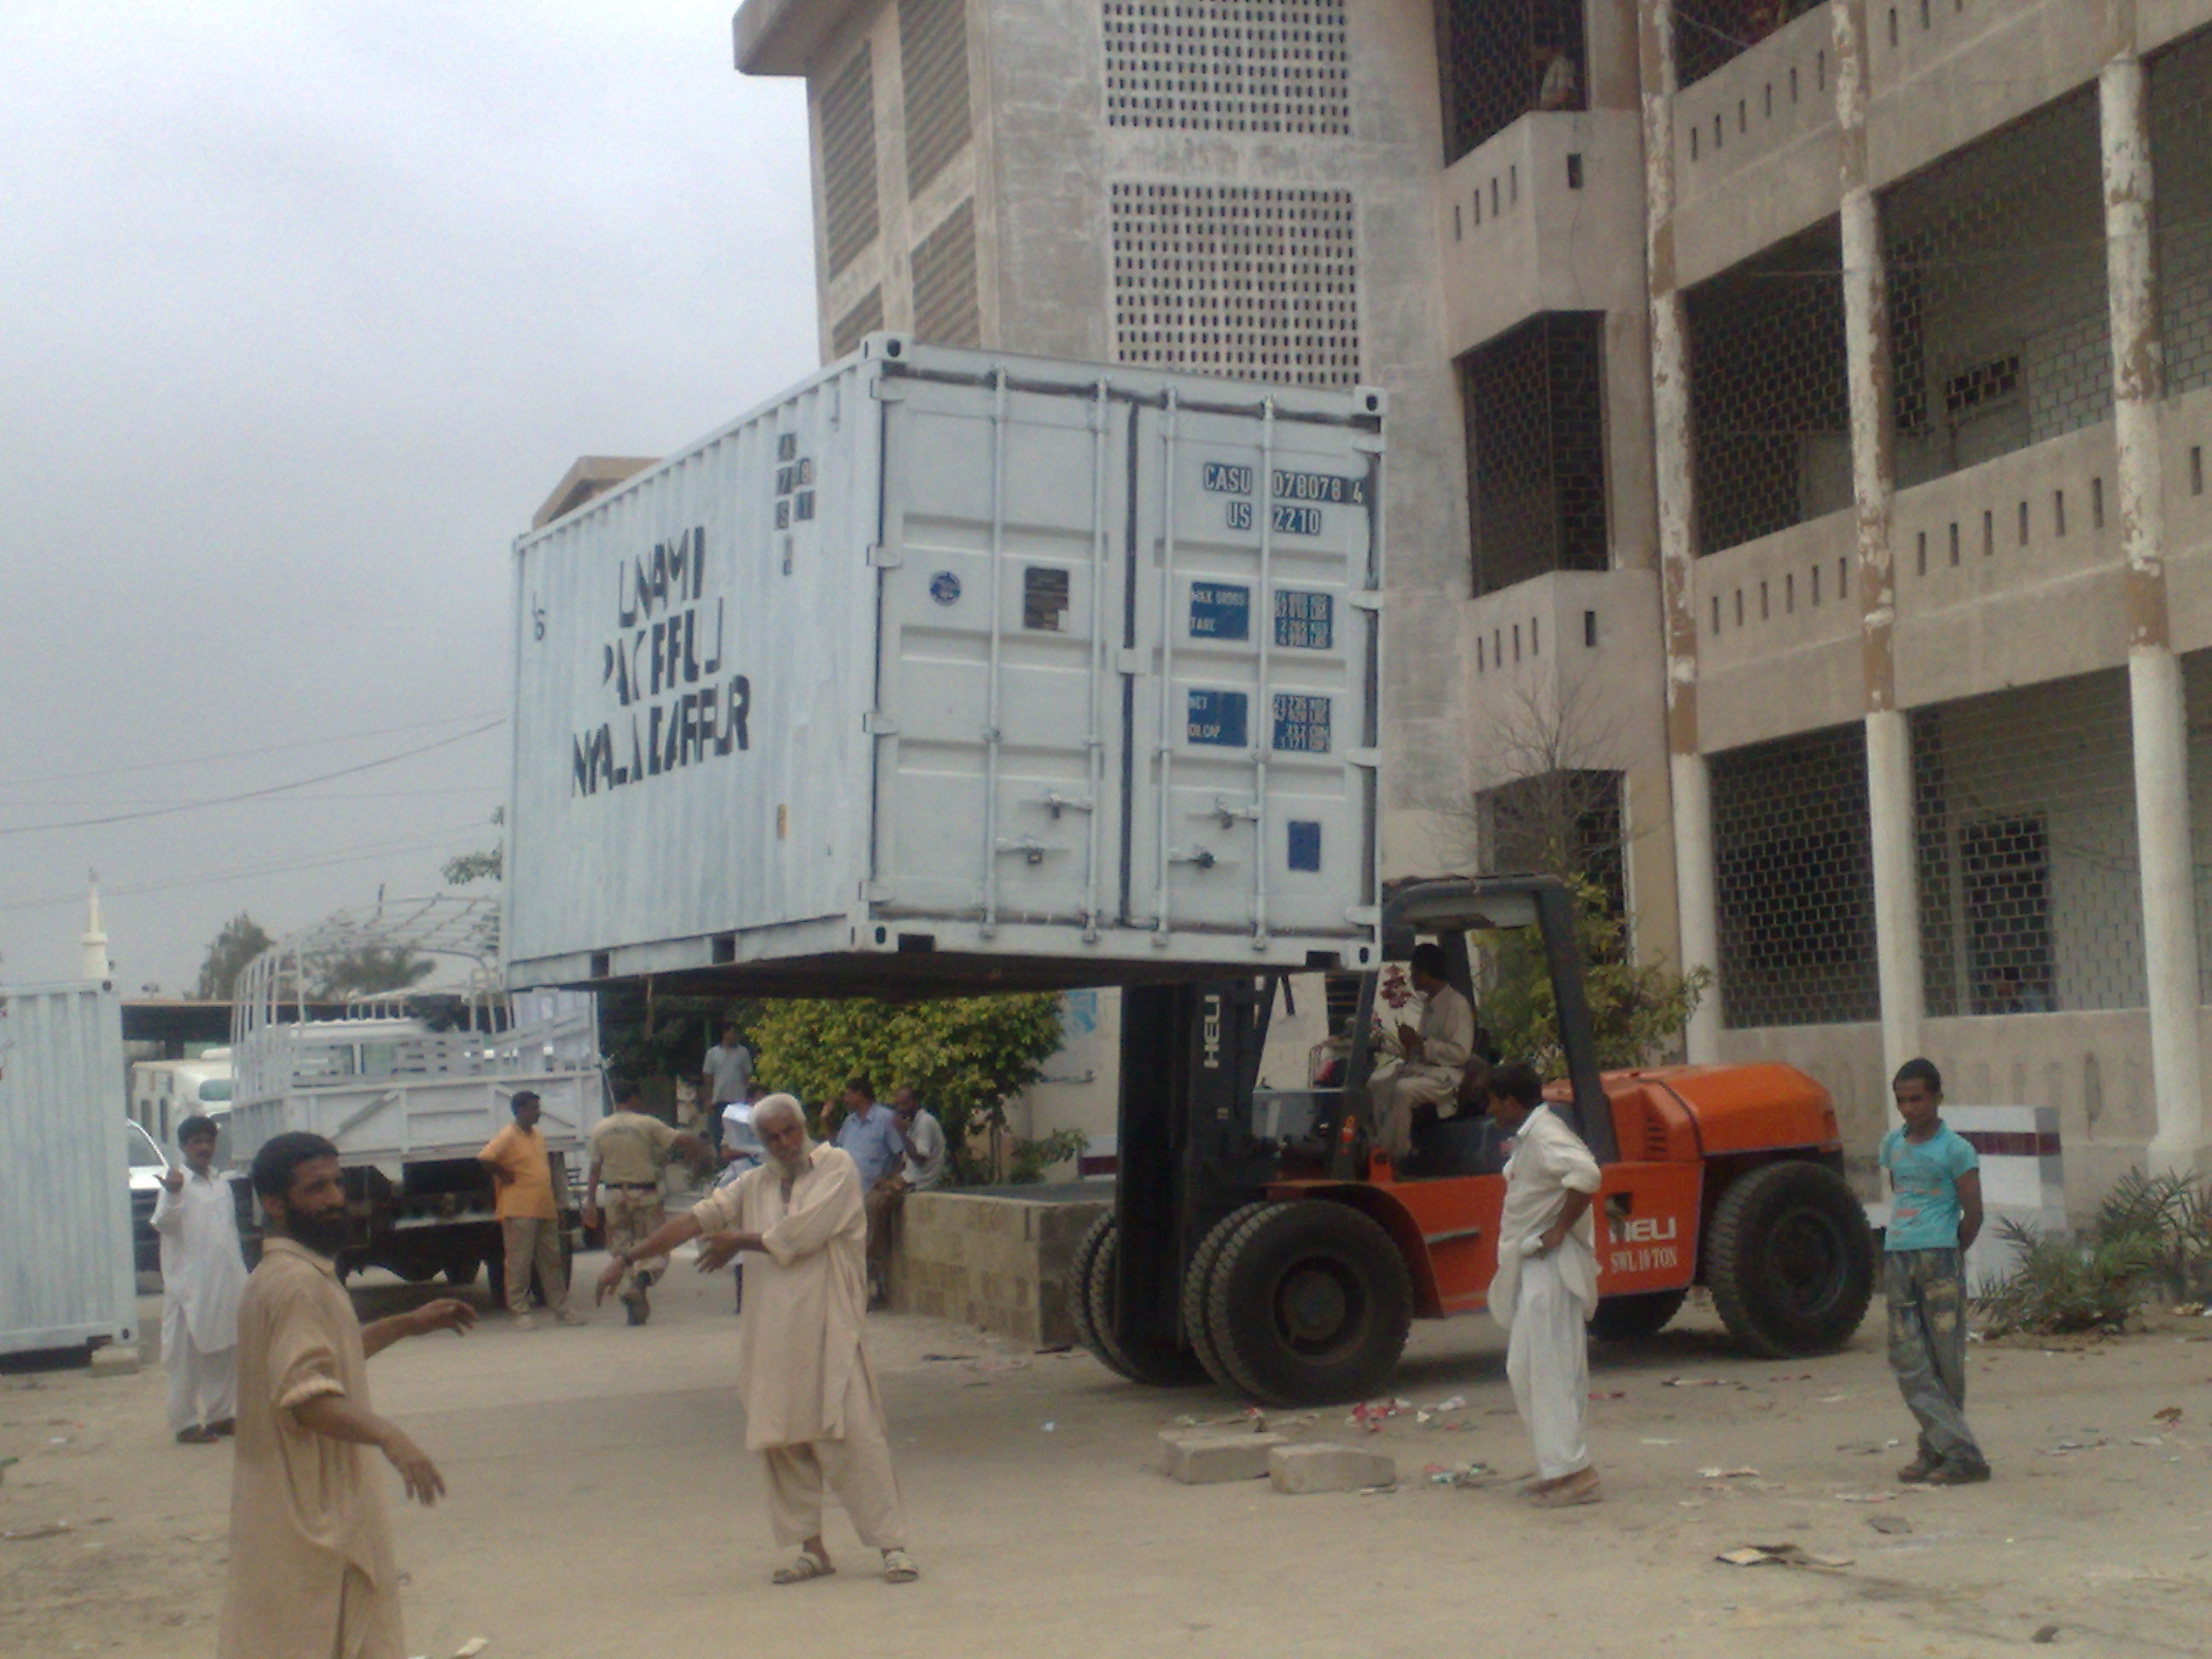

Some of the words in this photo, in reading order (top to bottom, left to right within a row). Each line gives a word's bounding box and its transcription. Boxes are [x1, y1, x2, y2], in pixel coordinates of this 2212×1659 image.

[1204, 463, 1252, 494] CASU
[1272, 471, 1342, 502] 078078
[1227, 500, 1251, 529] US
[1272, 505, 1320, 534] 2210
[1651, 1247, 1678, 1269] TON
